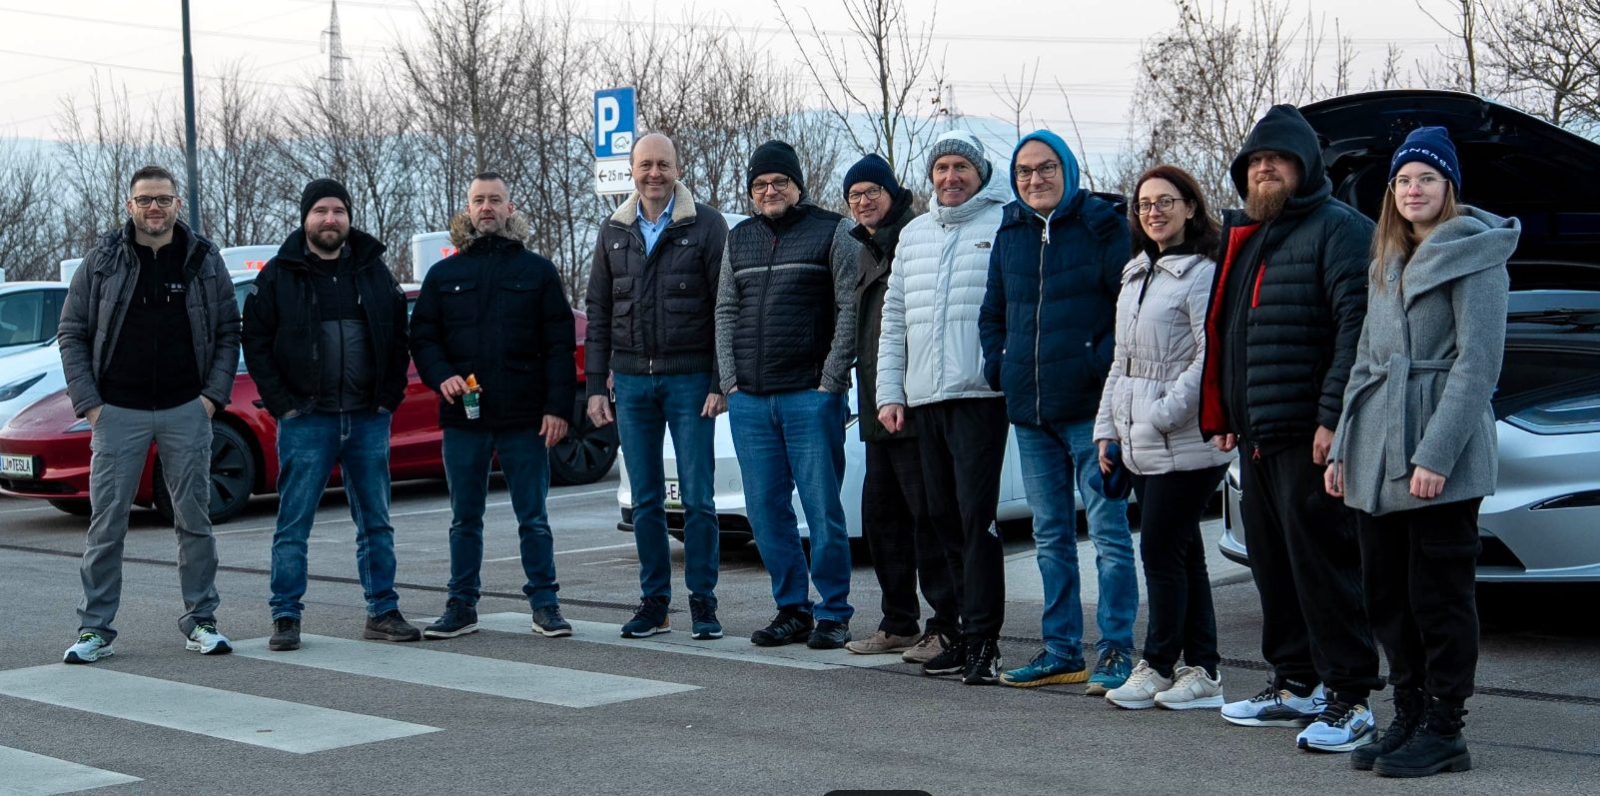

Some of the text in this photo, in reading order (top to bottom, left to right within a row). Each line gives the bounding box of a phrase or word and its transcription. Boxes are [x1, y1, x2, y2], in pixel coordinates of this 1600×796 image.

[597, 96, 620, 146] P
[608, 170, 624, 181] 25 m
